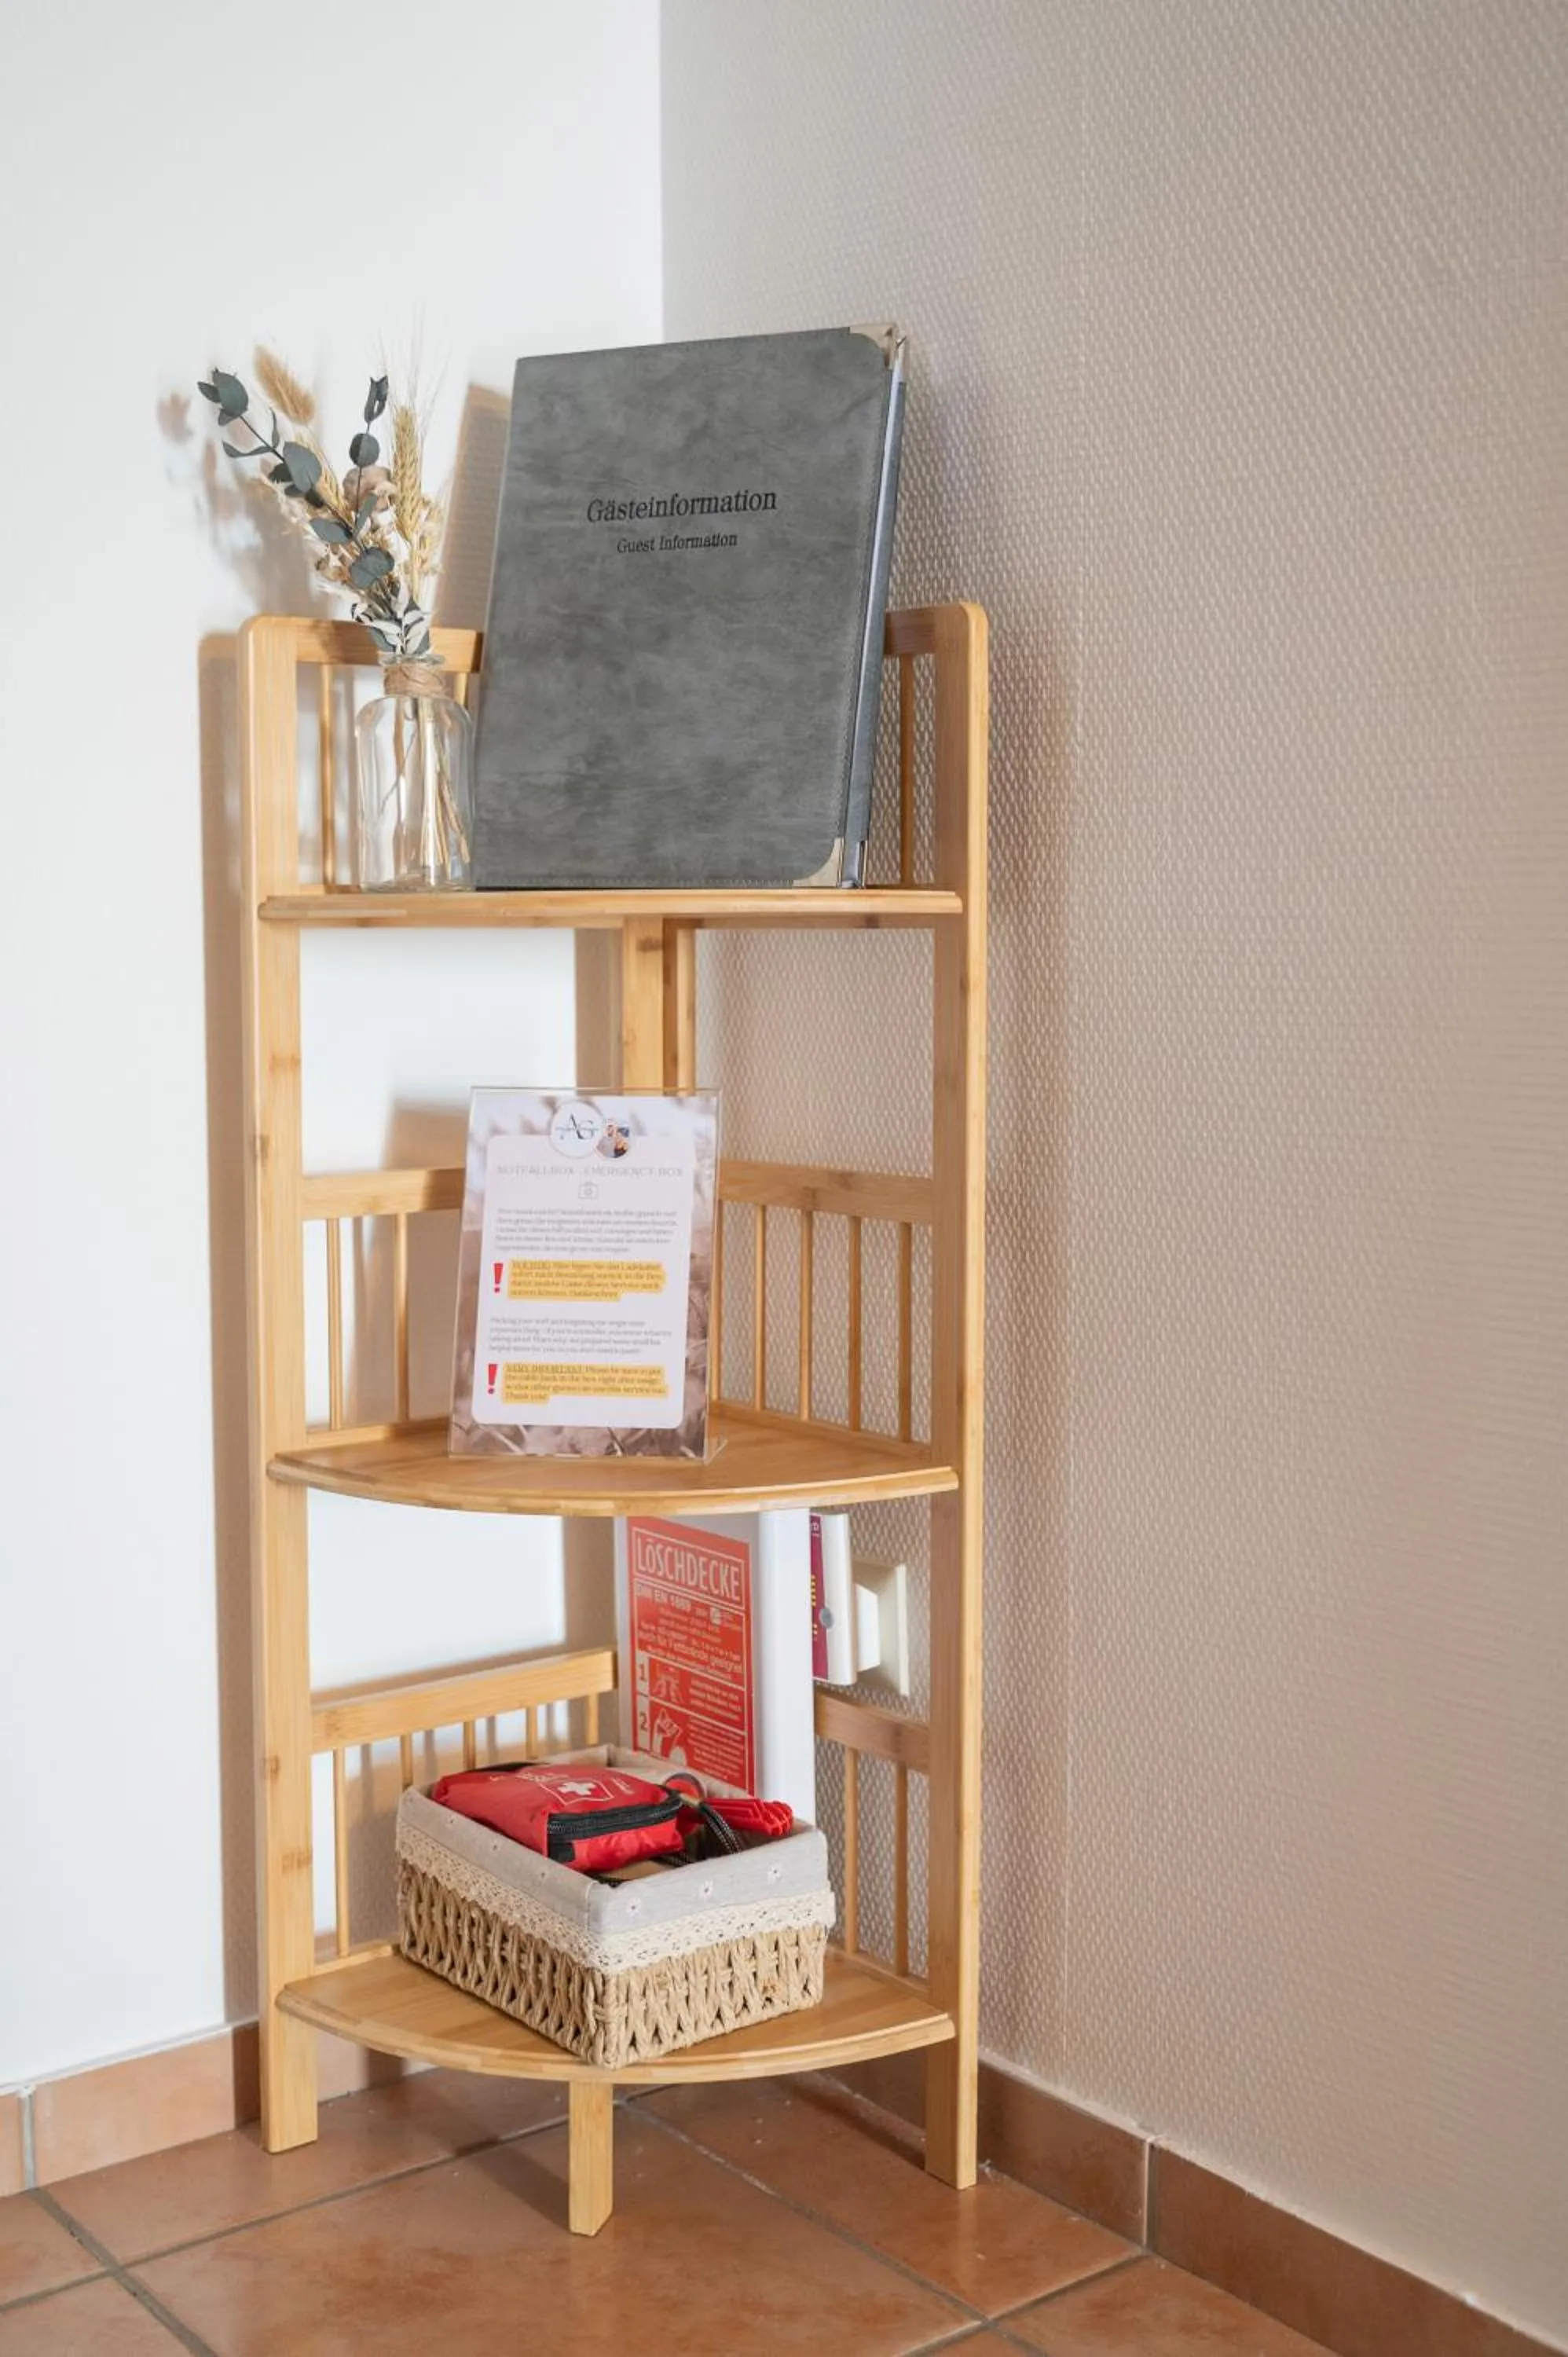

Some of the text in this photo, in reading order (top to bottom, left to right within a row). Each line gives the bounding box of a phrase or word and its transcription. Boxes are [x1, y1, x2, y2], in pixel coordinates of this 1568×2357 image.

[587, 489, 777, 523] Gästeinformation
[617, 533, 738, 553] Guest Information
[637, 1534, 741, 1601] LÖSCHDECKE
[639, 1662, 647, 1682] 1
[639, 1711, 647, 1732] 2
